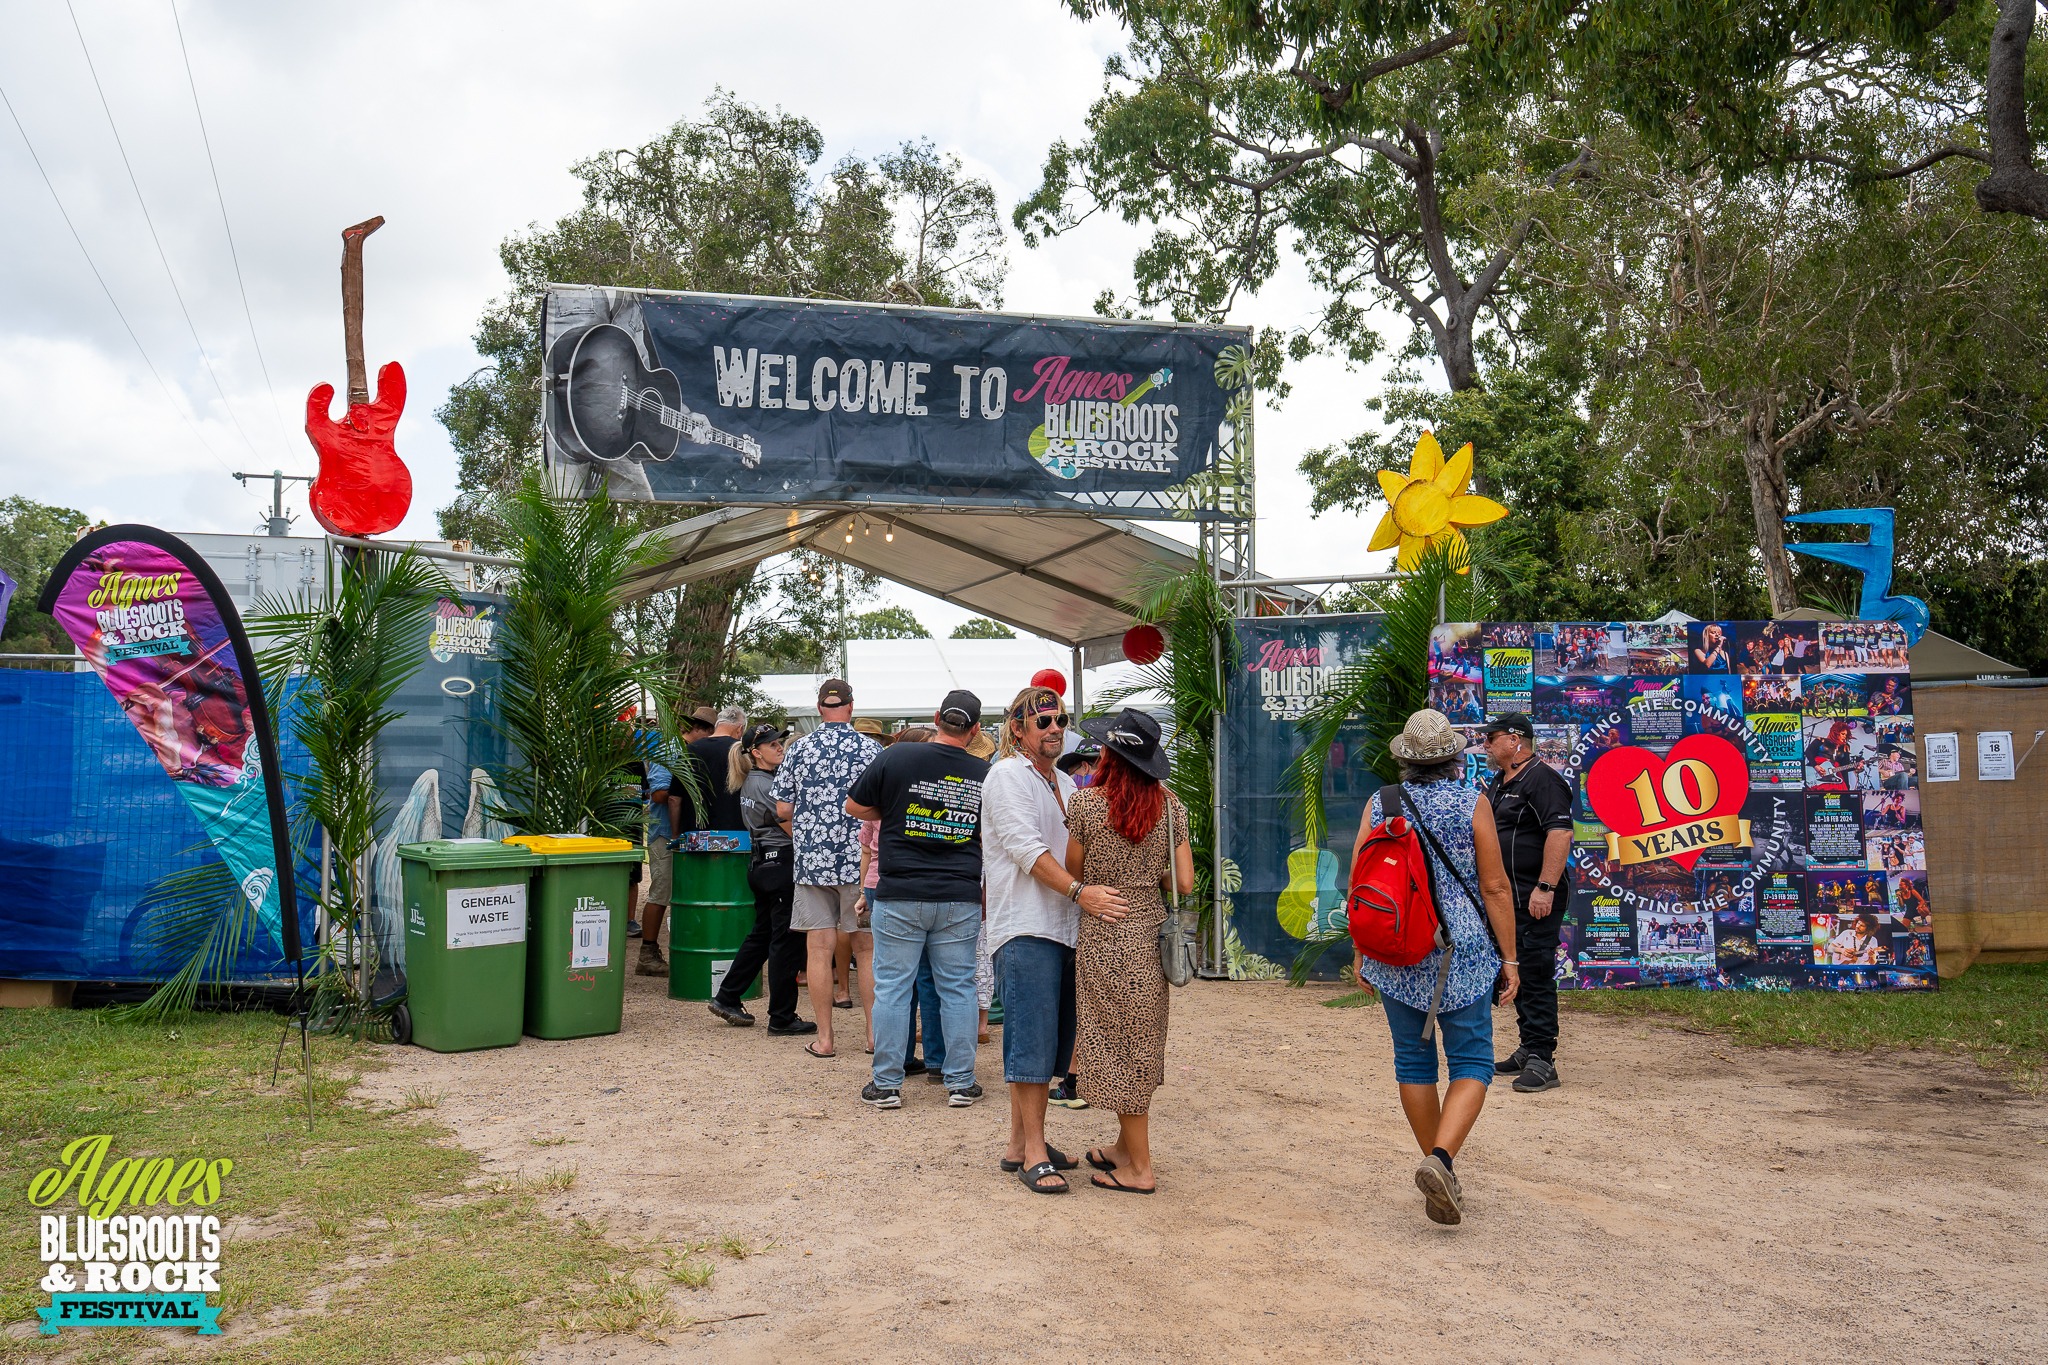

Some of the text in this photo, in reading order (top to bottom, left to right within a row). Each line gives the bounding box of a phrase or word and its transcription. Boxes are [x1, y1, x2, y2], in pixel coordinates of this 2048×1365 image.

[713, 345, 1008, 420] WELCOME TO
[1012, 355, 1134, 405] Agnes
[1057, 456, 1171, 474] FESTIVAL
[87, 571, 182, 610] Agnes
[113, 640, 179, 658] FESTIVAL
[440, 645, 488, 655] FESTIVAL
[1247, 639, 1328, 672] Agnes
[1487, 651, 1530, 668] Agnes
[1629, 679, 1663, 693] Agnes
[1625, 698, 1664, 717] THE
[1671, 697, 1773, 764] COMMUNITY
[1753, 716, 1799, 735] Agnes
[1989, 743, 2001, 752] 18
[1624, 758, 1720, 828] 10
[907, 803, 978, 824] Town of 1770
[905, 820, 931, 831] 19-21
[931, 824, 952, 834] FEB
[952, 828, 974, 836] 2021
[1631, 820, 1724, 859] YEARS
[1573, 847, 1684, 915] SUPPORTING
[1690, 893, 1728, 913] THE
[1731, 796, 1786, 898] COMMUNITY
[461, 894, 516, 909] GENERAL
[1592, 895, 1620, 907] Agnes
[468, 911, 509, 925] WASTE
[567, 971, 596, 991] Only
